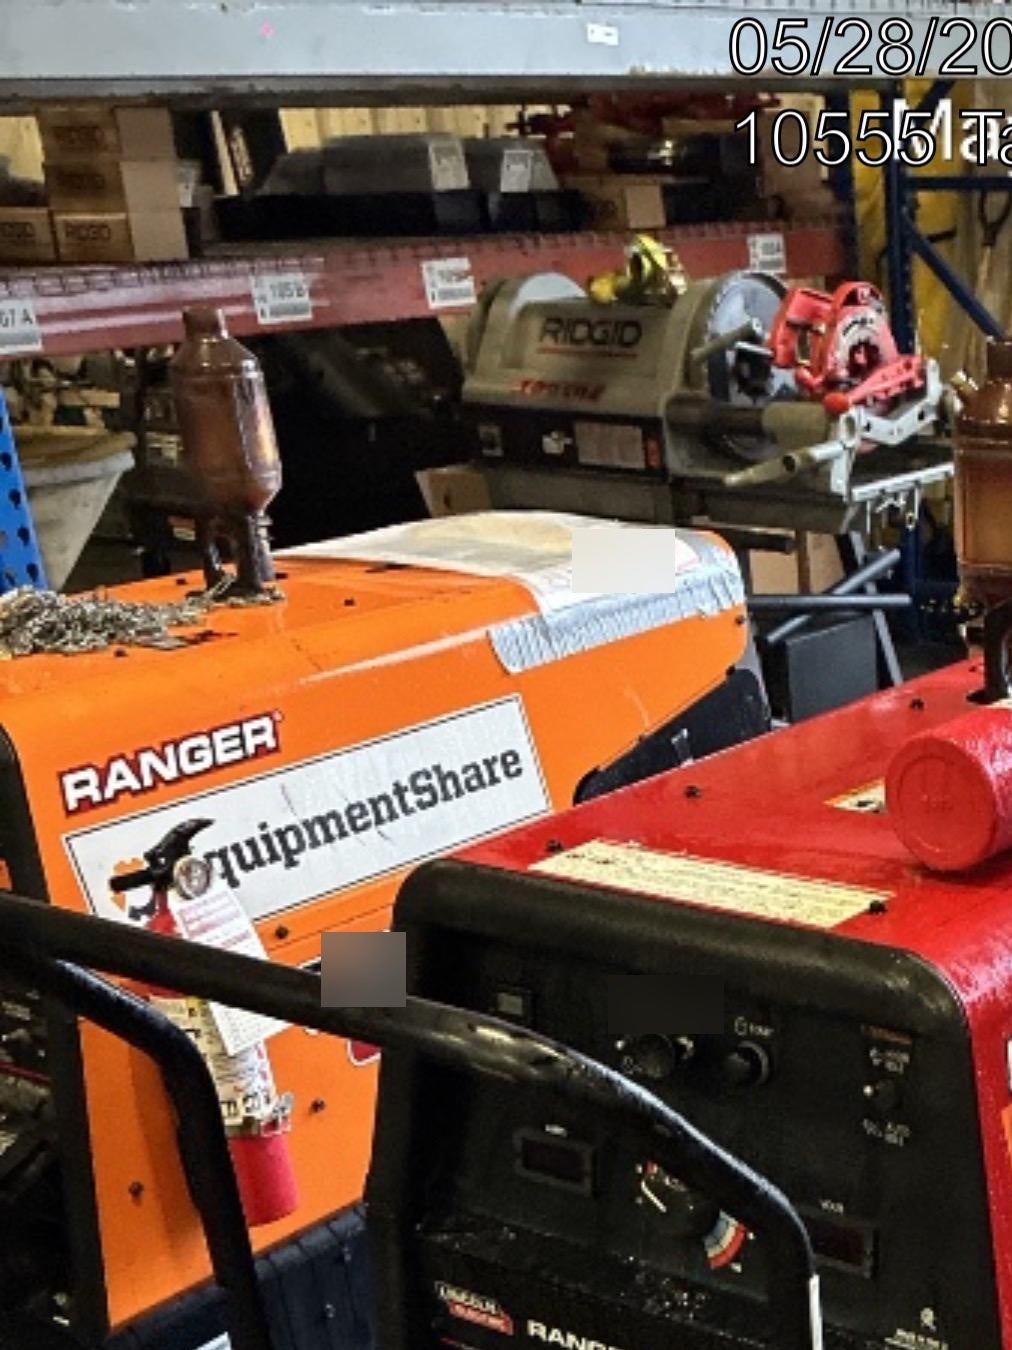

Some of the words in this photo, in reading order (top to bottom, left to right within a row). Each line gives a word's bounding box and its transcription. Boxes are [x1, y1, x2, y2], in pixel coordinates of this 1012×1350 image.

[540, 317, 643, 347] RIDGID
[62, 716, 278, 812] RANGER
[204, 747, 524, 889] quipmentShare
